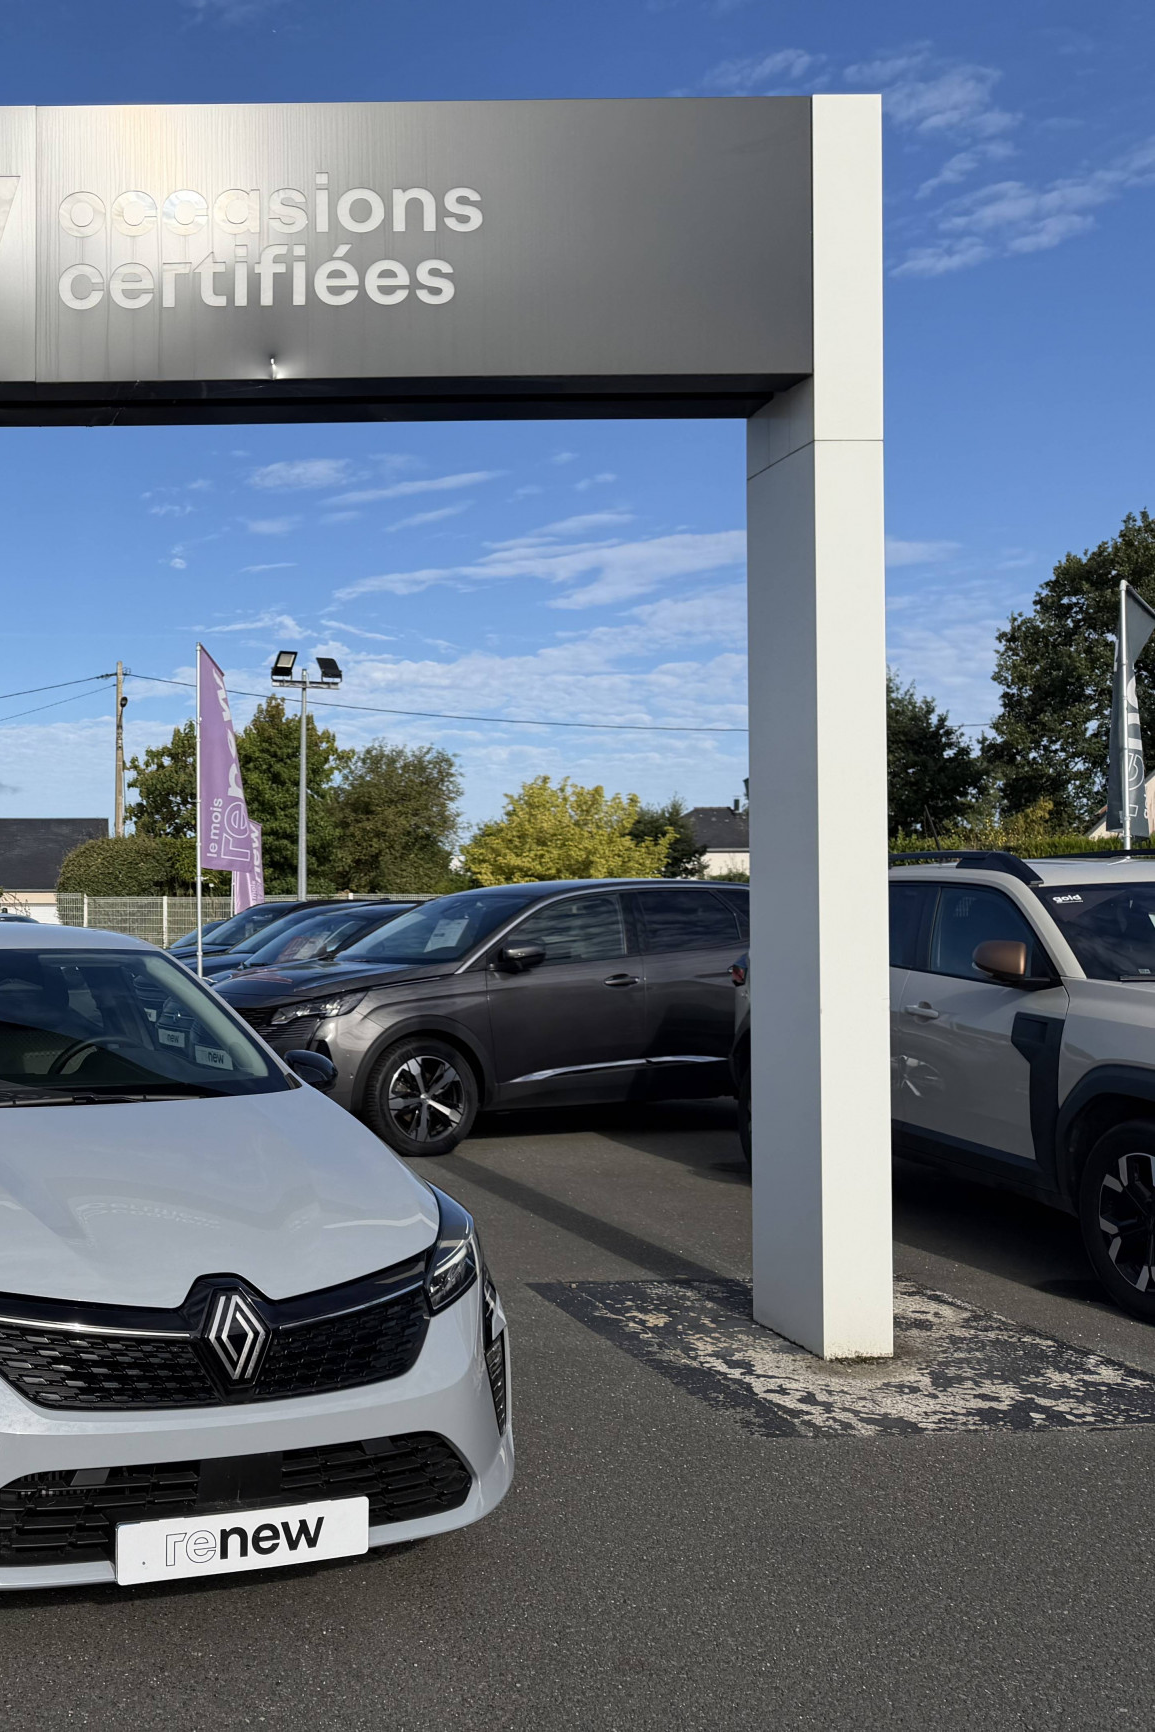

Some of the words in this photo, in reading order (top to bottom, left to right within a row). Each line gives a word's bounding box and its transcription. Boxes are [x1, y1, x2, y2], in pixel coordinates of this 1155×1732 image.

[58, 171, 484, 238] occasions
[58, 244, 455, 310] certifiées
[210, 798, 223, 840] mois
[207, 842, 219, 857] le
[164, 1516, 325, 1567] renew
